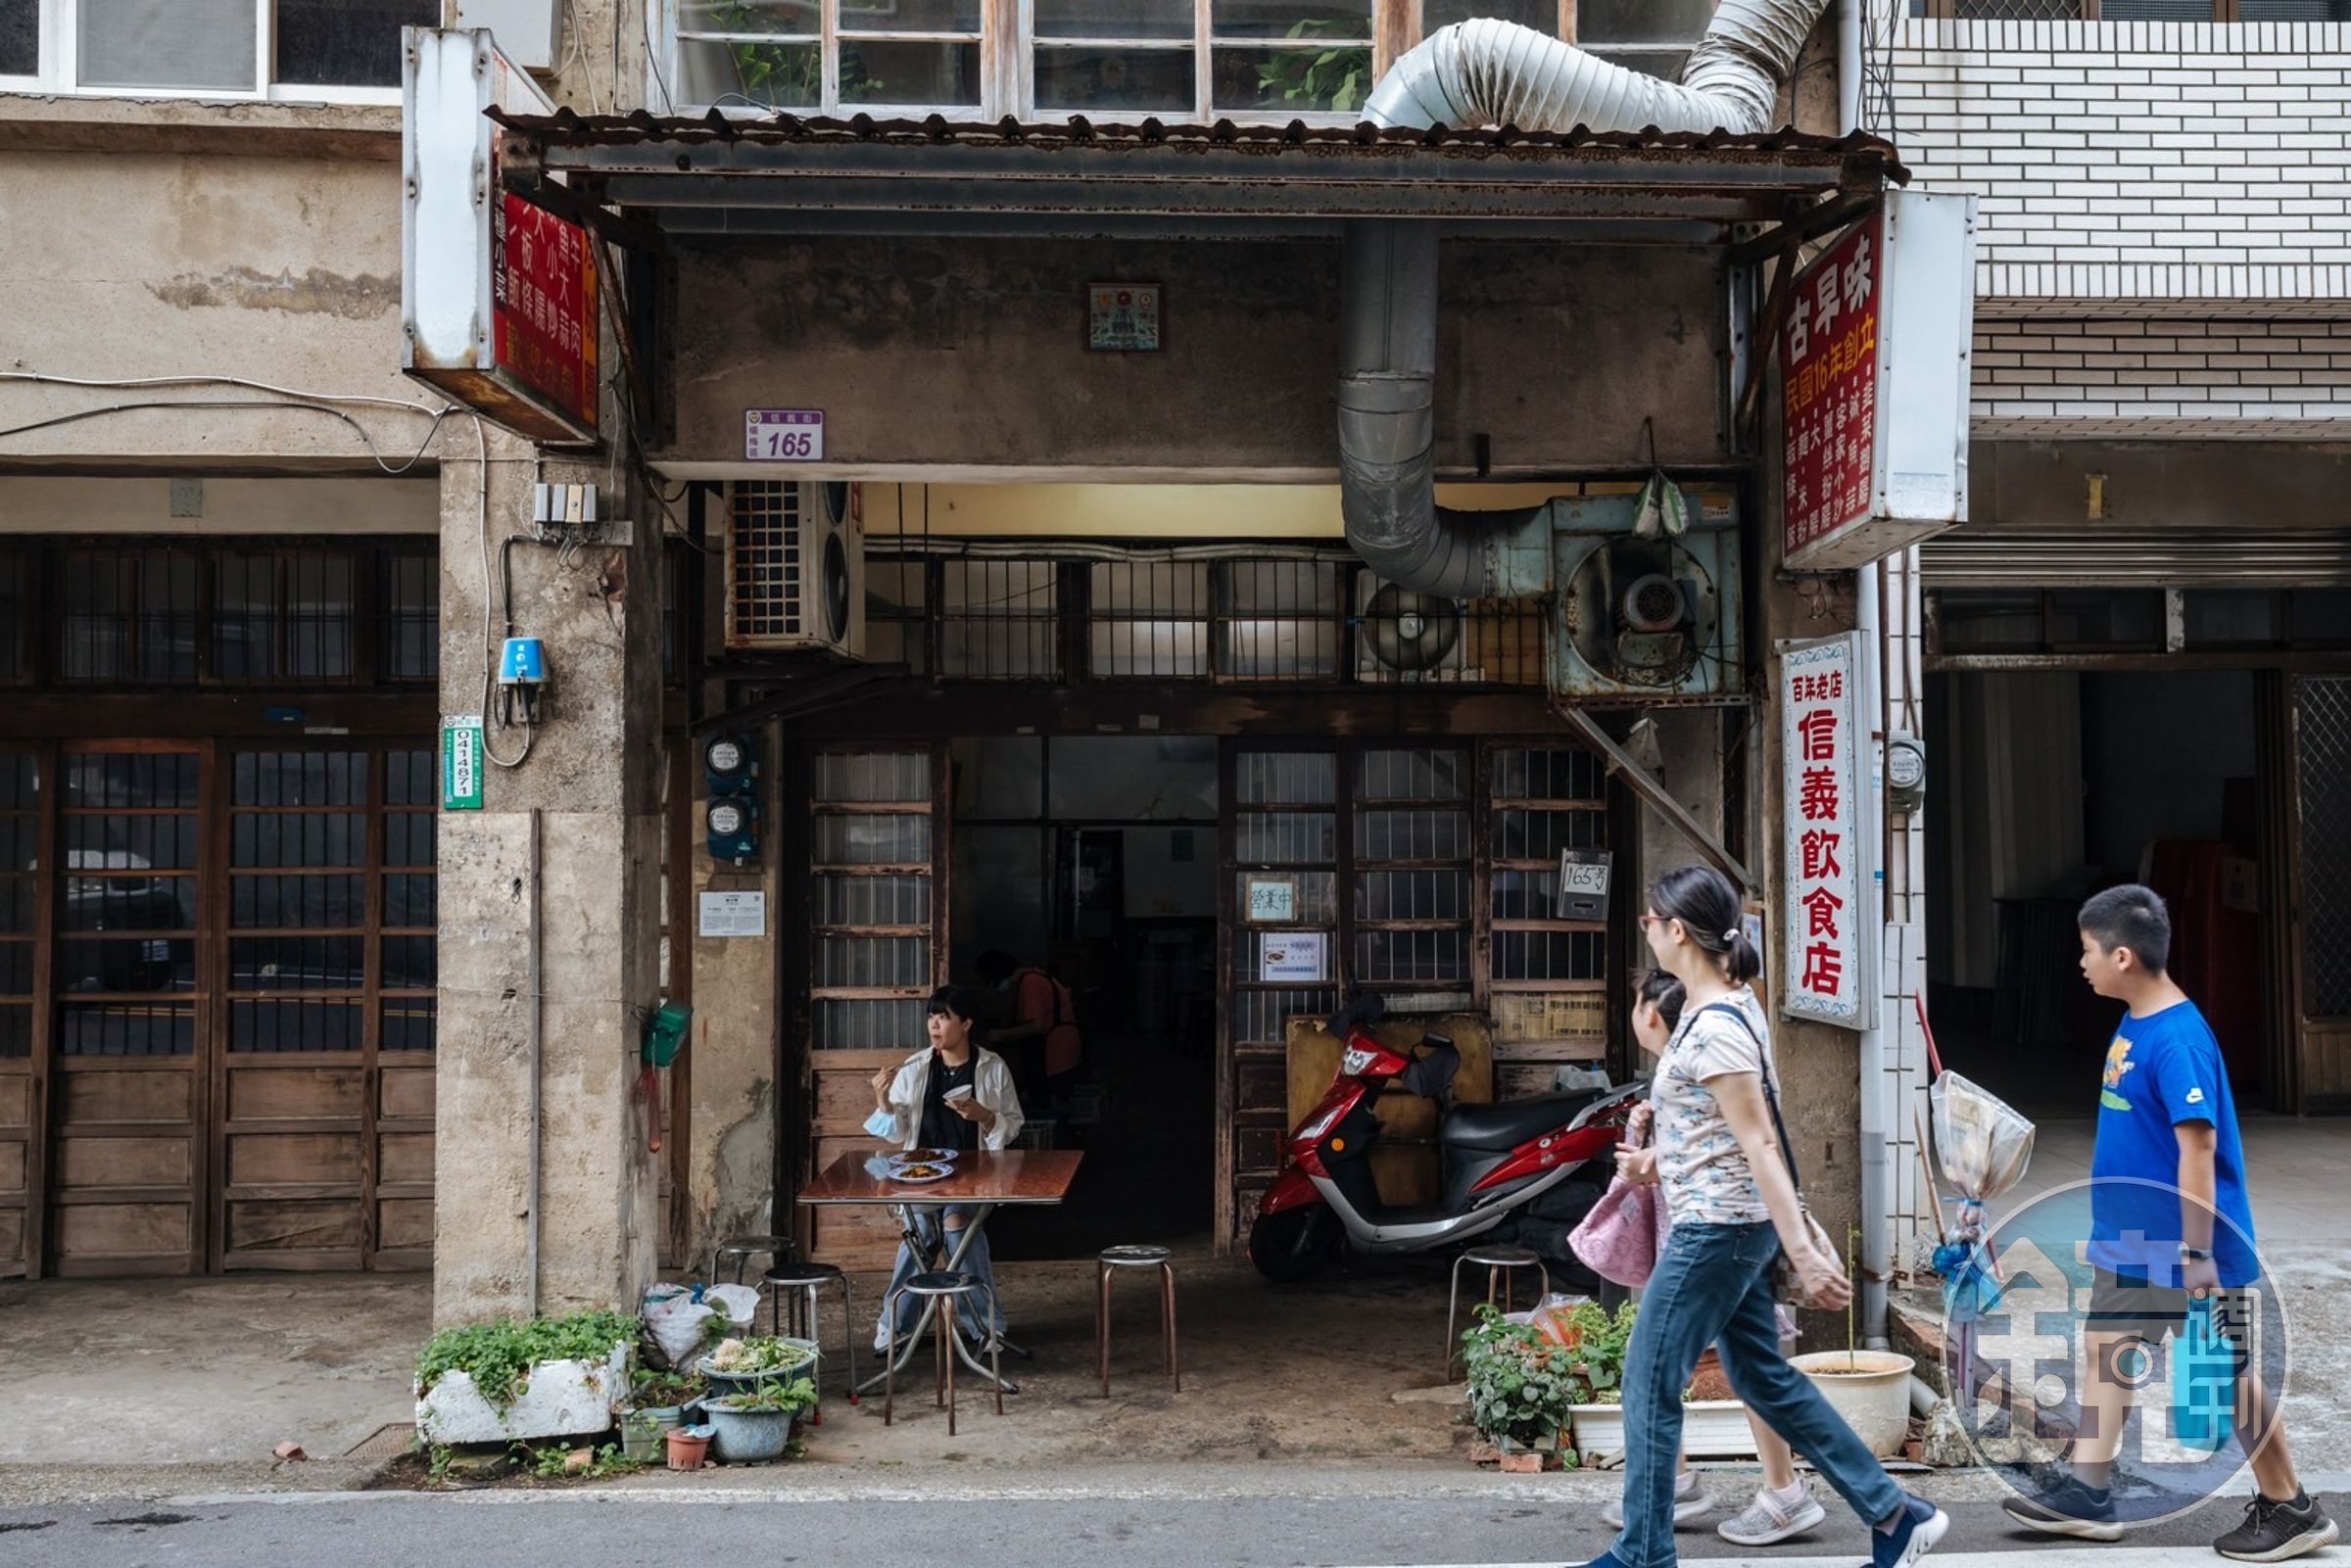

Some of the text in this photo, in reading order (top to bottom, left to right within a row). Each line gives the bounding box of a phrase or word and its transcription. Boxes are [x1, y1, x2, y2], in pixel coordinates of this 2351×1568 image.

[547, 213, 558, 340] 小炒
[1786, 234, 1872, 366] 古早味
[1786, 312, 1874, 419] 民國16年創立
[768, 432, 812, 456] 165
[1833, 402, 1847, 524] 客家小炒
[1792, 670, 1844, 703] 百年老店
[457, 732, 469, 794] 0414871
[1251, 887, 1292, 911] 營業中
[1797, 709, 1844, 997] 信義飲食店
